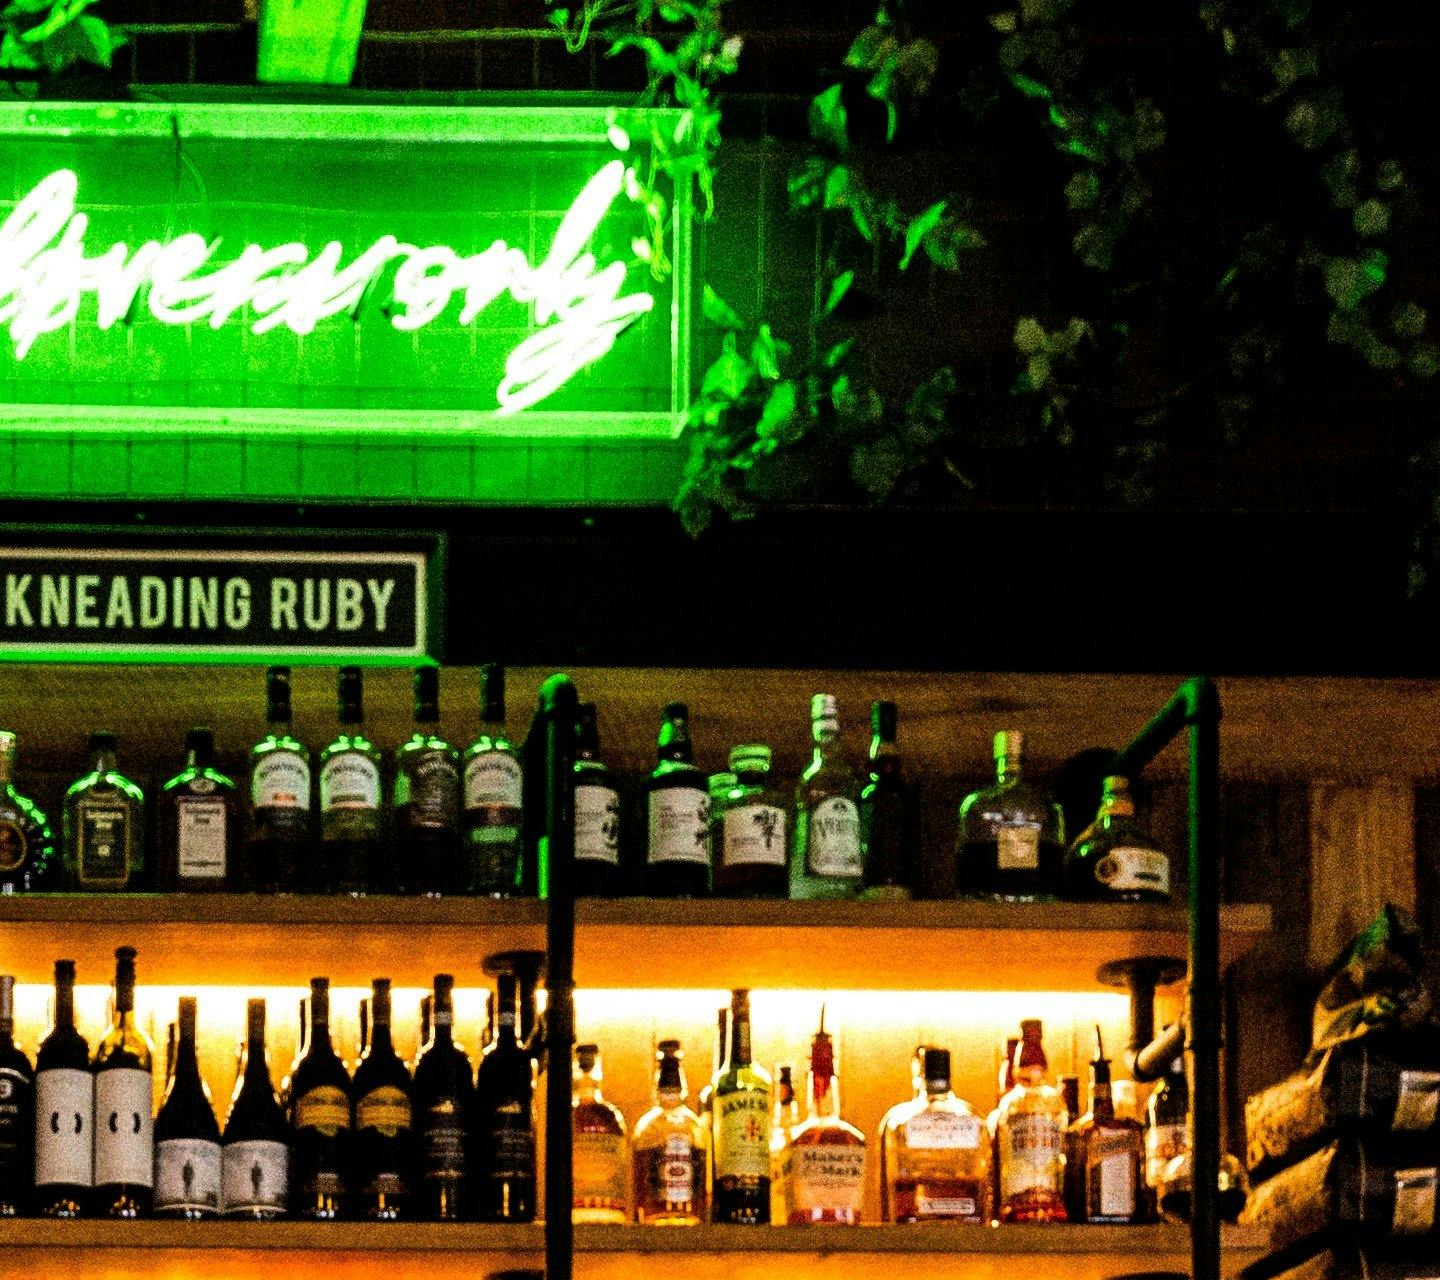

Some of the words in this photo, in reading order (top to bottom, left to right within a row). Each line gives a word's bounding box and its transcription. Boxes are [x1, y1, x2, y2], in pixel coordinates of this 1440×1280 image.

[390, 160, 654, 413] only
[5, 573, 252, 631] KNEADING
[270, 576, 396, 632] RUBY
